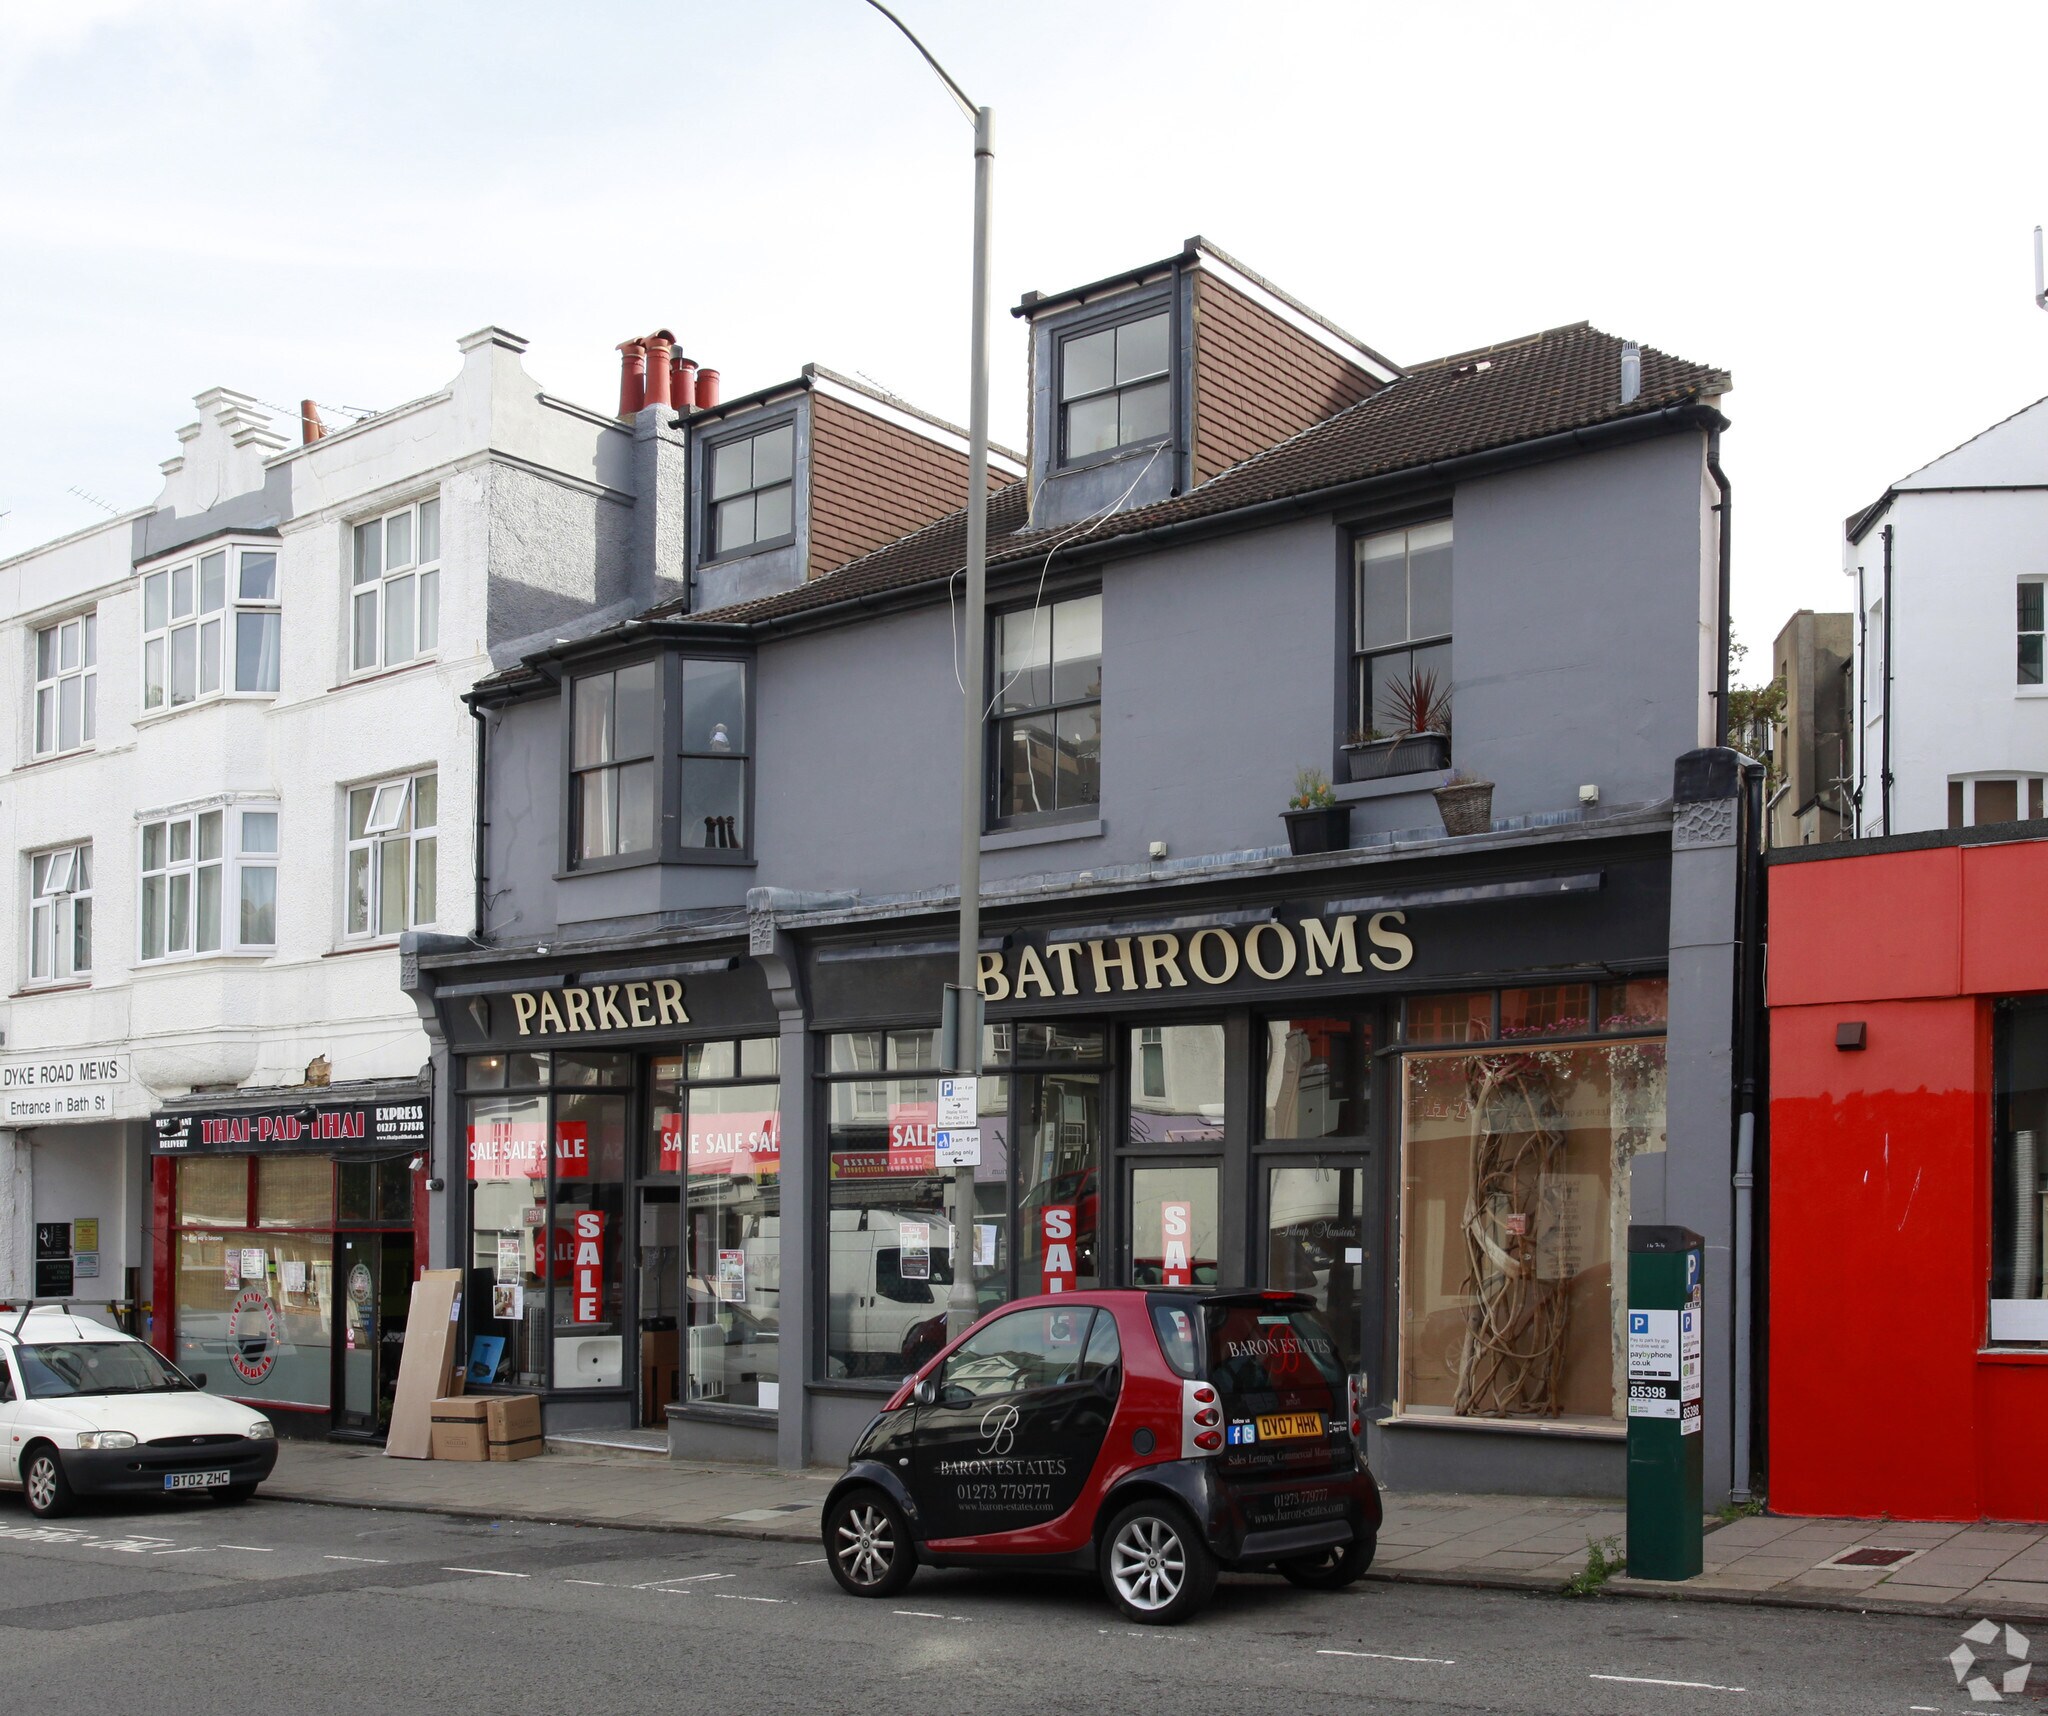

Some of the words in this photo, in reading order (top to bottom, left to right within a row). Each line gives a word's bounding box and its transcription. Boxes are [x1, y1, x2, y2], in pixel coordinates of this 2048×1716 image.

[978, 911, 1414, 1002] BATHROOMS
[511, 978, 690, 1036] PARKER
[4, 1067, 35, 1086] DYKE
[40, 1064, 74, 1083] ROAD
[80, 1060, 118, 1081] MEWS
[944, 1081, 952, 1096] P
[11, 1101, 51, 1115] Entrance
[54, 1099, 63, 1113] in
[67, 1097, 90, 1112] Bath
[95, 1095, 105, 1110] St
[376, 1105, 423, 1121] EXPRESS
[376, 1122, 397, 1132] 01273
[159, 1139, 188, 1149] DELIVERY
[663, 1132, 700, 1154] SAE
[706, 1132, 743, 1154] SALE
[748, 1131, 779, 1153] SAL
[892, 1124, 937, 1148] SALE
[469, 1142, 499, 1161] SALE
[503, 1140, 537, 1161] SALE
[577, 1213, 601, 1321] SALE
[1687, 1254, 1696, 1285] P
[1634, 1317, 1644, 1330] P
[1685, 1316, 1691, 1329] P
[1227, 1338, 1279, 1357] BARON
[1280, 1338, 1331, 1354] ESTATES
[1630, 1350, 1673, 1359] paybyphone
[1630, 1385, 1667, 1399] 85398
[977, 1404, 1020, 1455] B
[1297, 1415, 1318, 1434] HHK
[940, 1460, 993, 1475] BARON
[996, 1460, 1067, 1475] ESTATES
[1228, 1454, 1247, 1466] Sales
[206, 1472, 228, 1485] ZHC
[957, 1484, 997, 1499] 01273
[1000, 1484, 1051, 1499] 779777
[1274, 1492, 1299, 1508] 01273
[1300, 1488, 1328, 1503] 779777
[958, 1501, 1054, 1512] www.baron-estates.com
